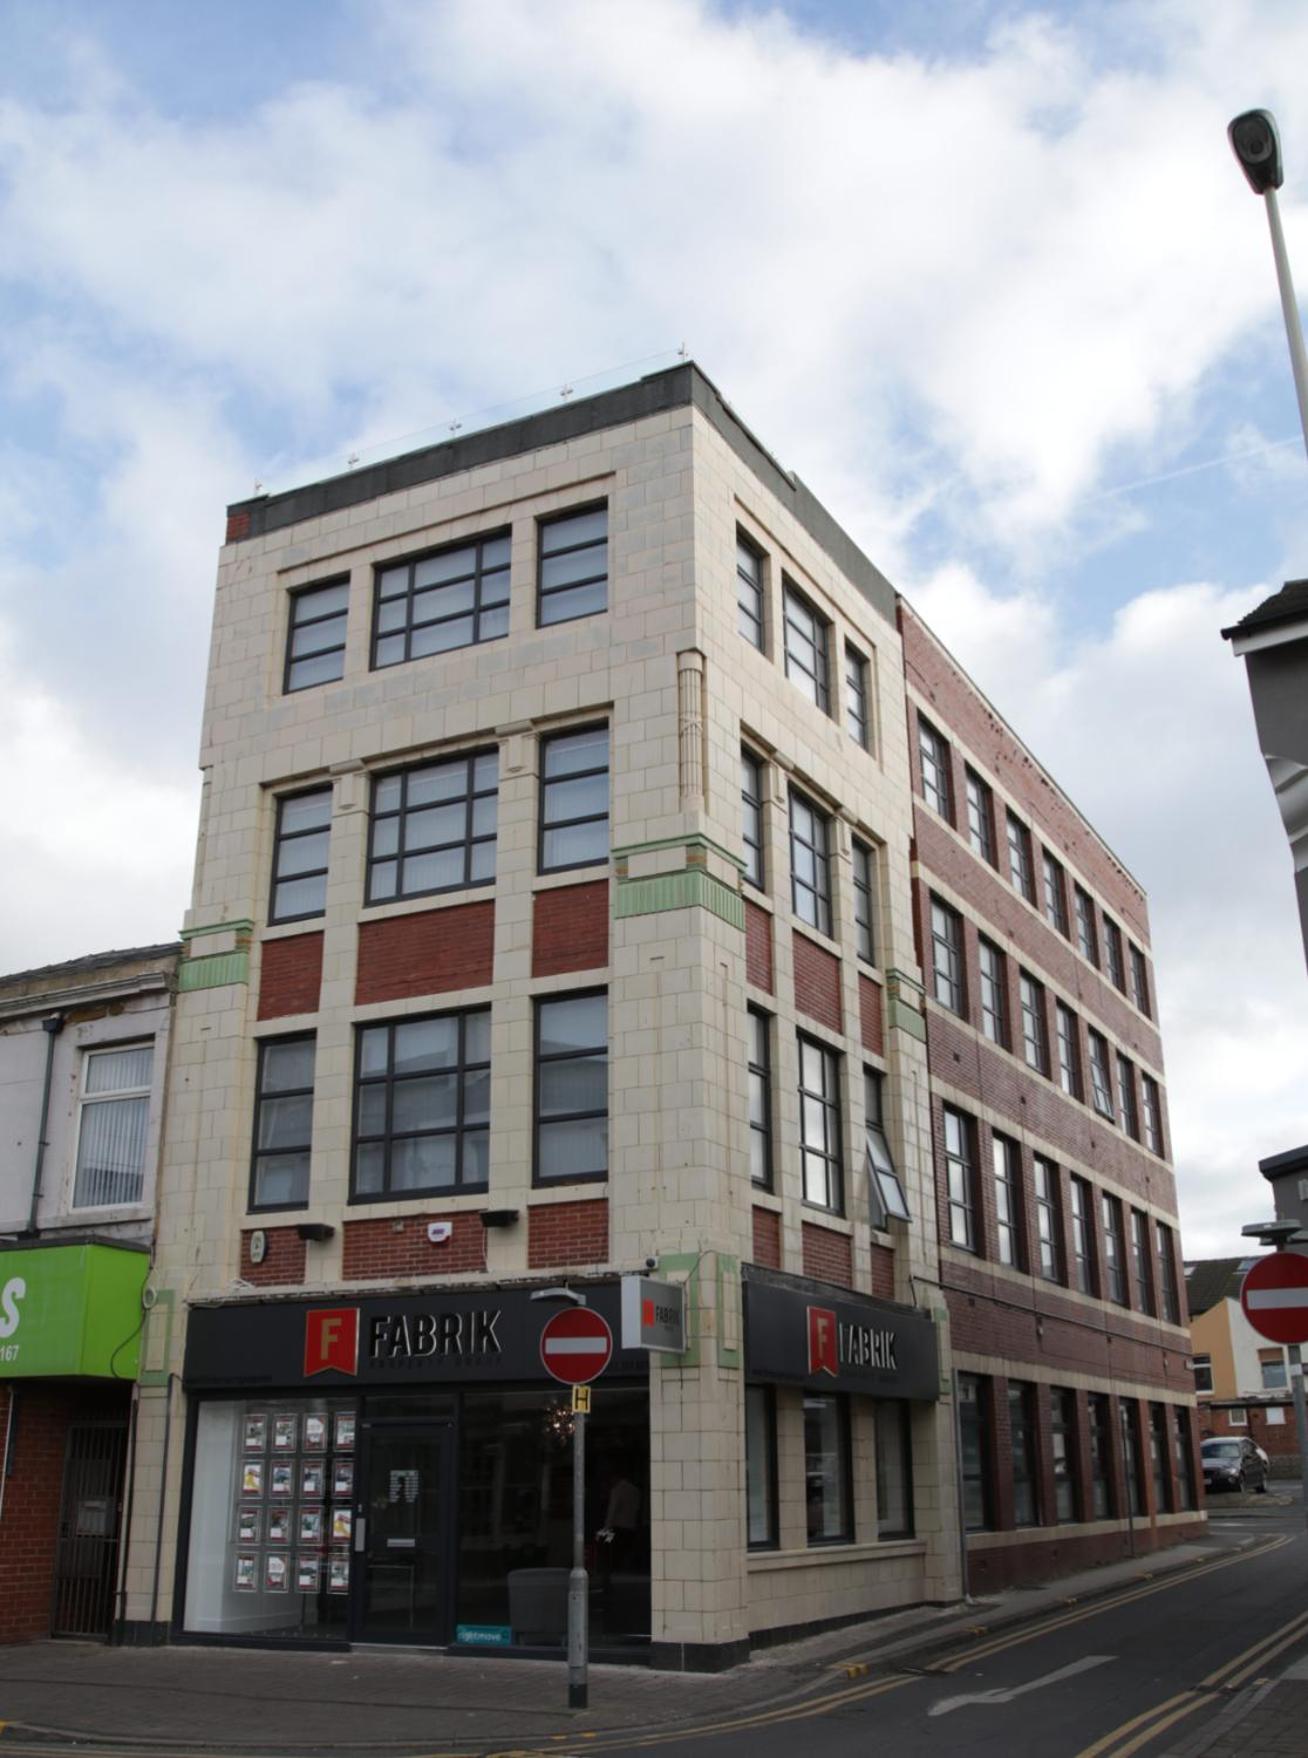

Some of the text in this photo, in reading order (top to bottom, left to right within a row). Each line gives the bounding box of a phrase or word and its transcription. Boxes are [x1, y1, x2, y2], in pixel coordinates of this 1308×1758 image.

[320, 1310, 502, 1361] F FABRIK
[816, 1317, 897, 1371] F FABRIK
[575, 1388, 588, 1411] H
